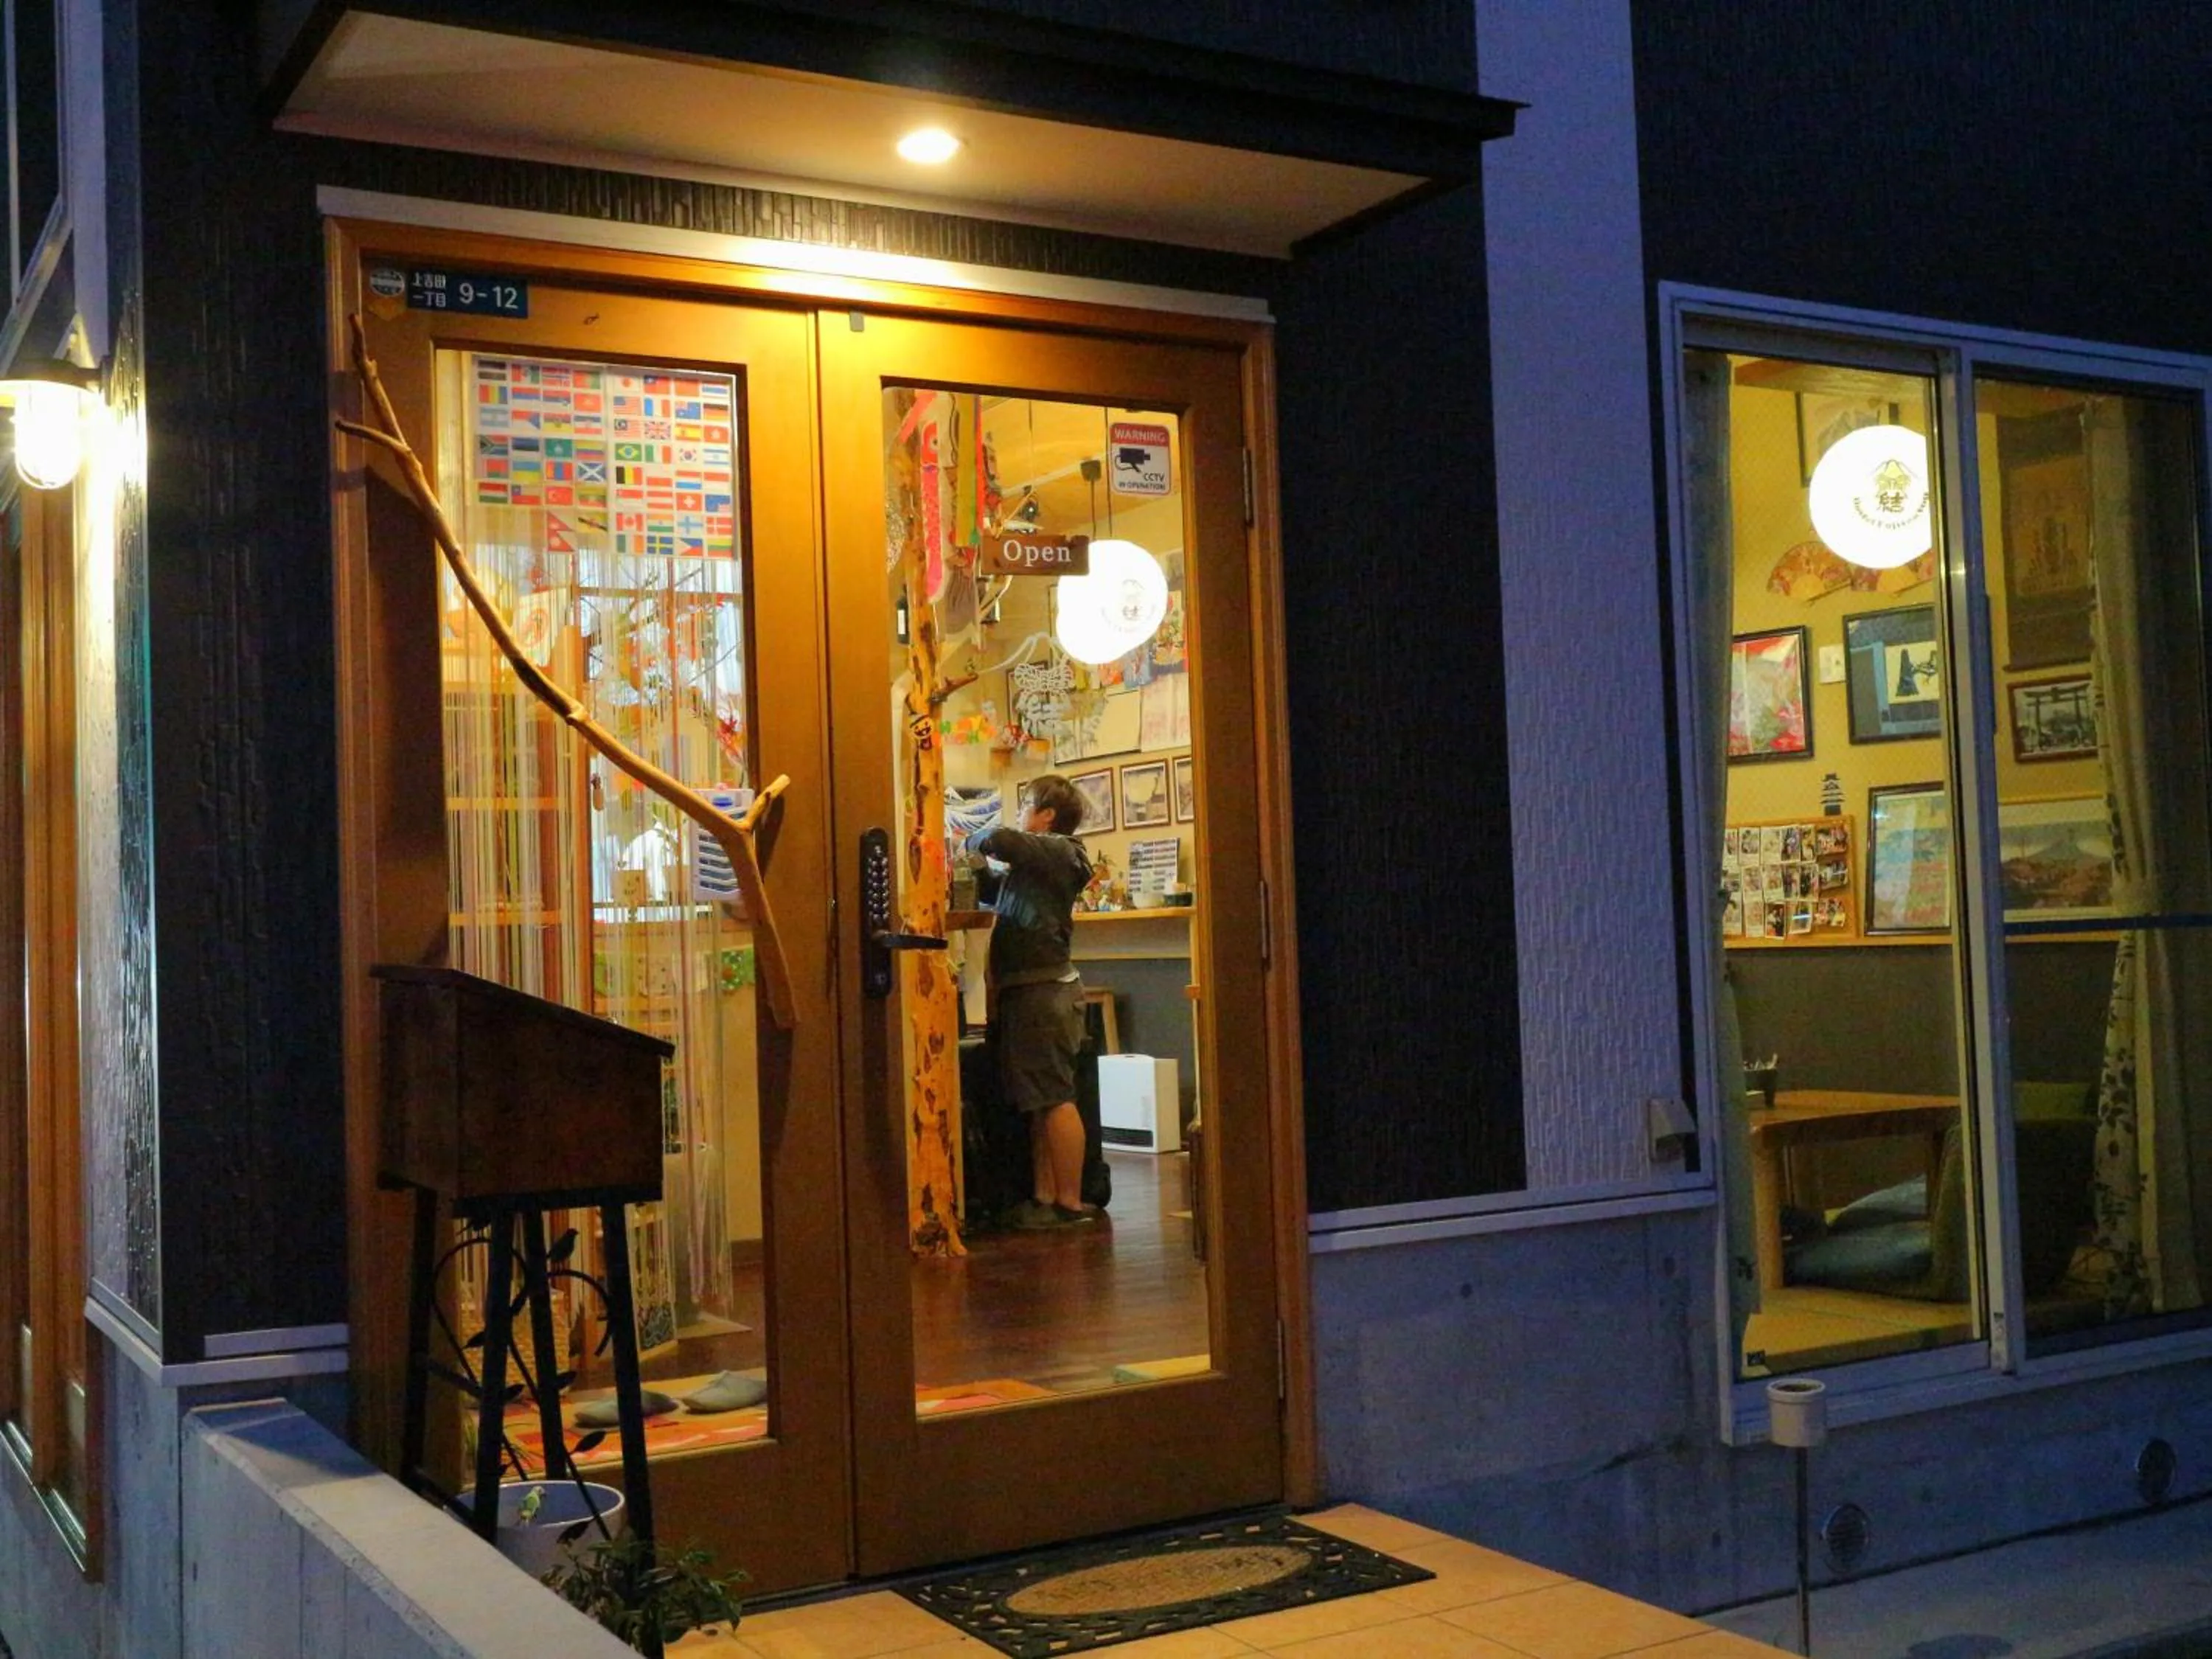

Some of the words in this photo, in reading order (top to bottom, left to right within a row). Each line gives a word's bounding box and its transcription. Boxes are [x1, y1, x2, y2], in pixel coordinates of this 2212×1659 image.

[412, 291, 447, 307] 一丁目
[459, 282, 518, 310] 9-12
[1114, 428, 1166, 442] WARNING
[1144, 473, 1165, 481] CCTV
[1003, 539, 1072, 568] Open
